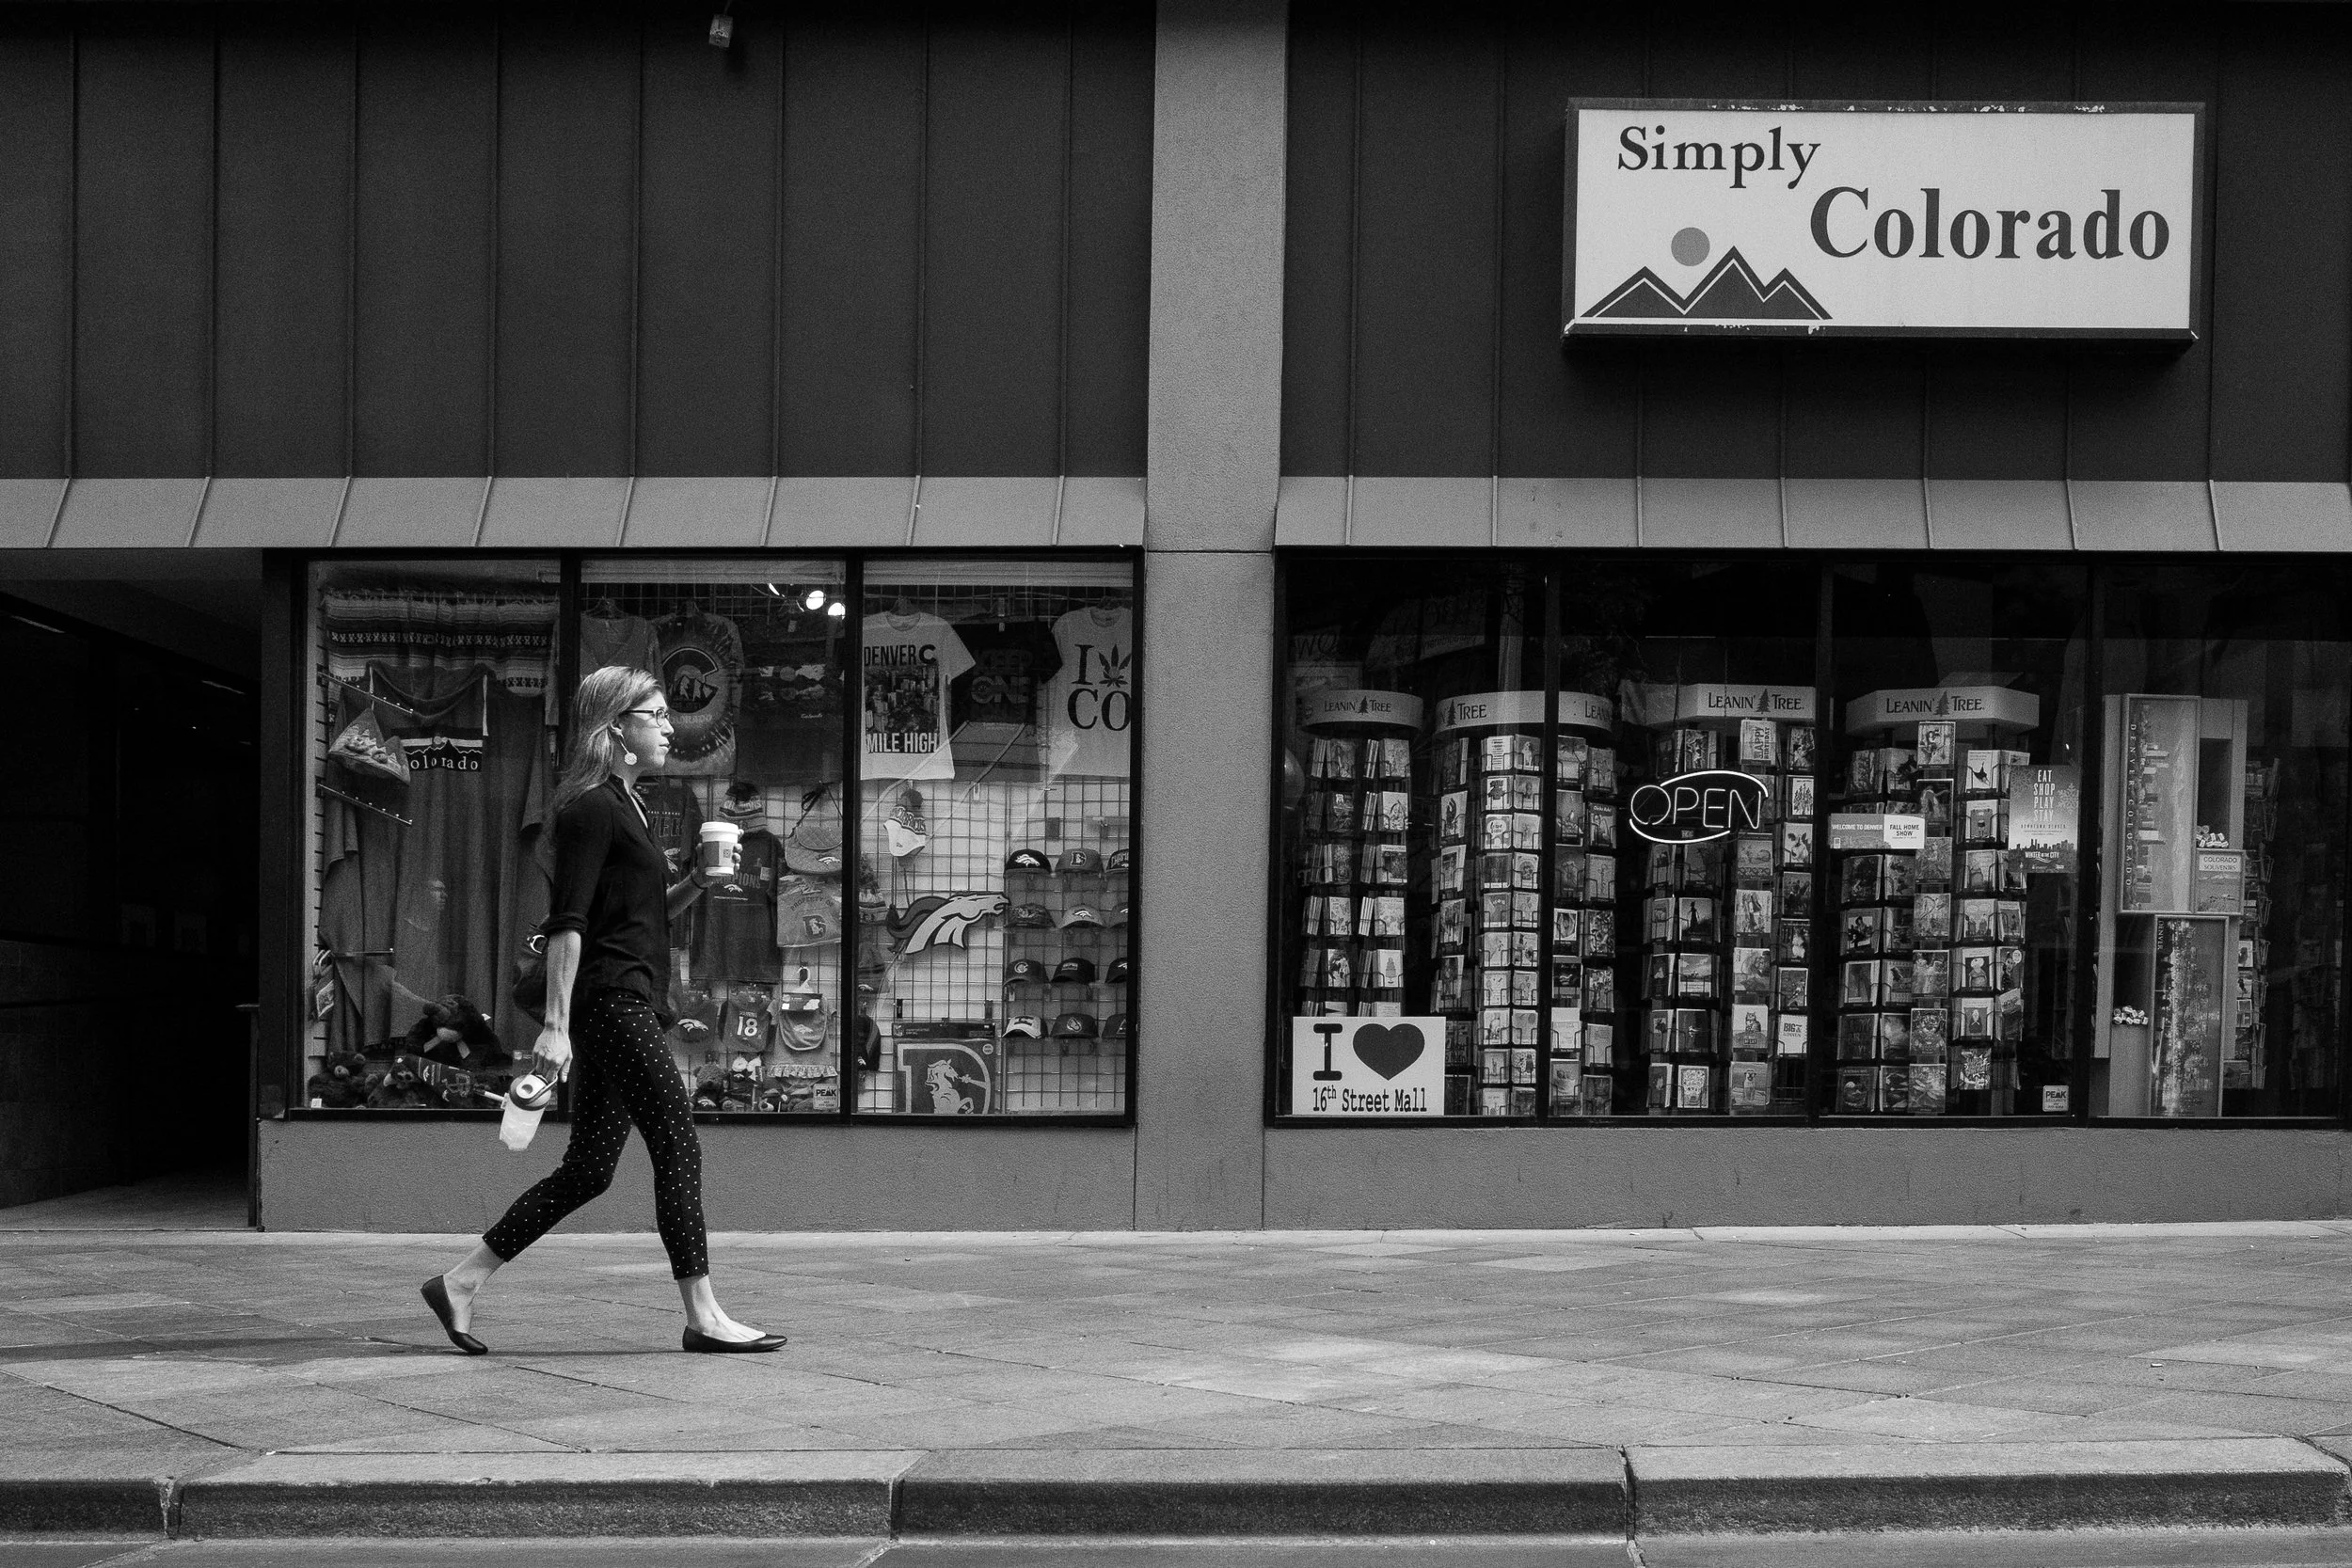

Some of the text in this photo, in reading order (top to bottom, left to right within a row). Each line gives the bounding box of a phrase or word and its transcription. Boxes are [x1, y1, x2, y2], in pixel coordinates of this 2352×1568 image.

[1616, 125, 1821, 190] Simply
[1810, 186, 2170, 261] Colorado
[865, 644, 916, 667] DENVER
[1067, 688, 1131, 732] CO
[866, 733, 939, 754] MILE HIGH
[410, 755, 479, 770] olorado
[2037, 769, 2053, 783] EAT
[2033, 783, 2056, 796] SHOP
[1630, 784, 1761, 830] OPEN
[2033, 796, 2055, 809] PLAY
[2033, 809, 2055, 822] STAY
[737, 1016, 758, 1037] 18
[1312, 1023, 1343, 1082] I
[816, 1087, 836, 1097] PEAK
[1313, 1084, 1427, 1112] 16th Street Mall
[2045, 1090, 2067, 1099] PEAK
